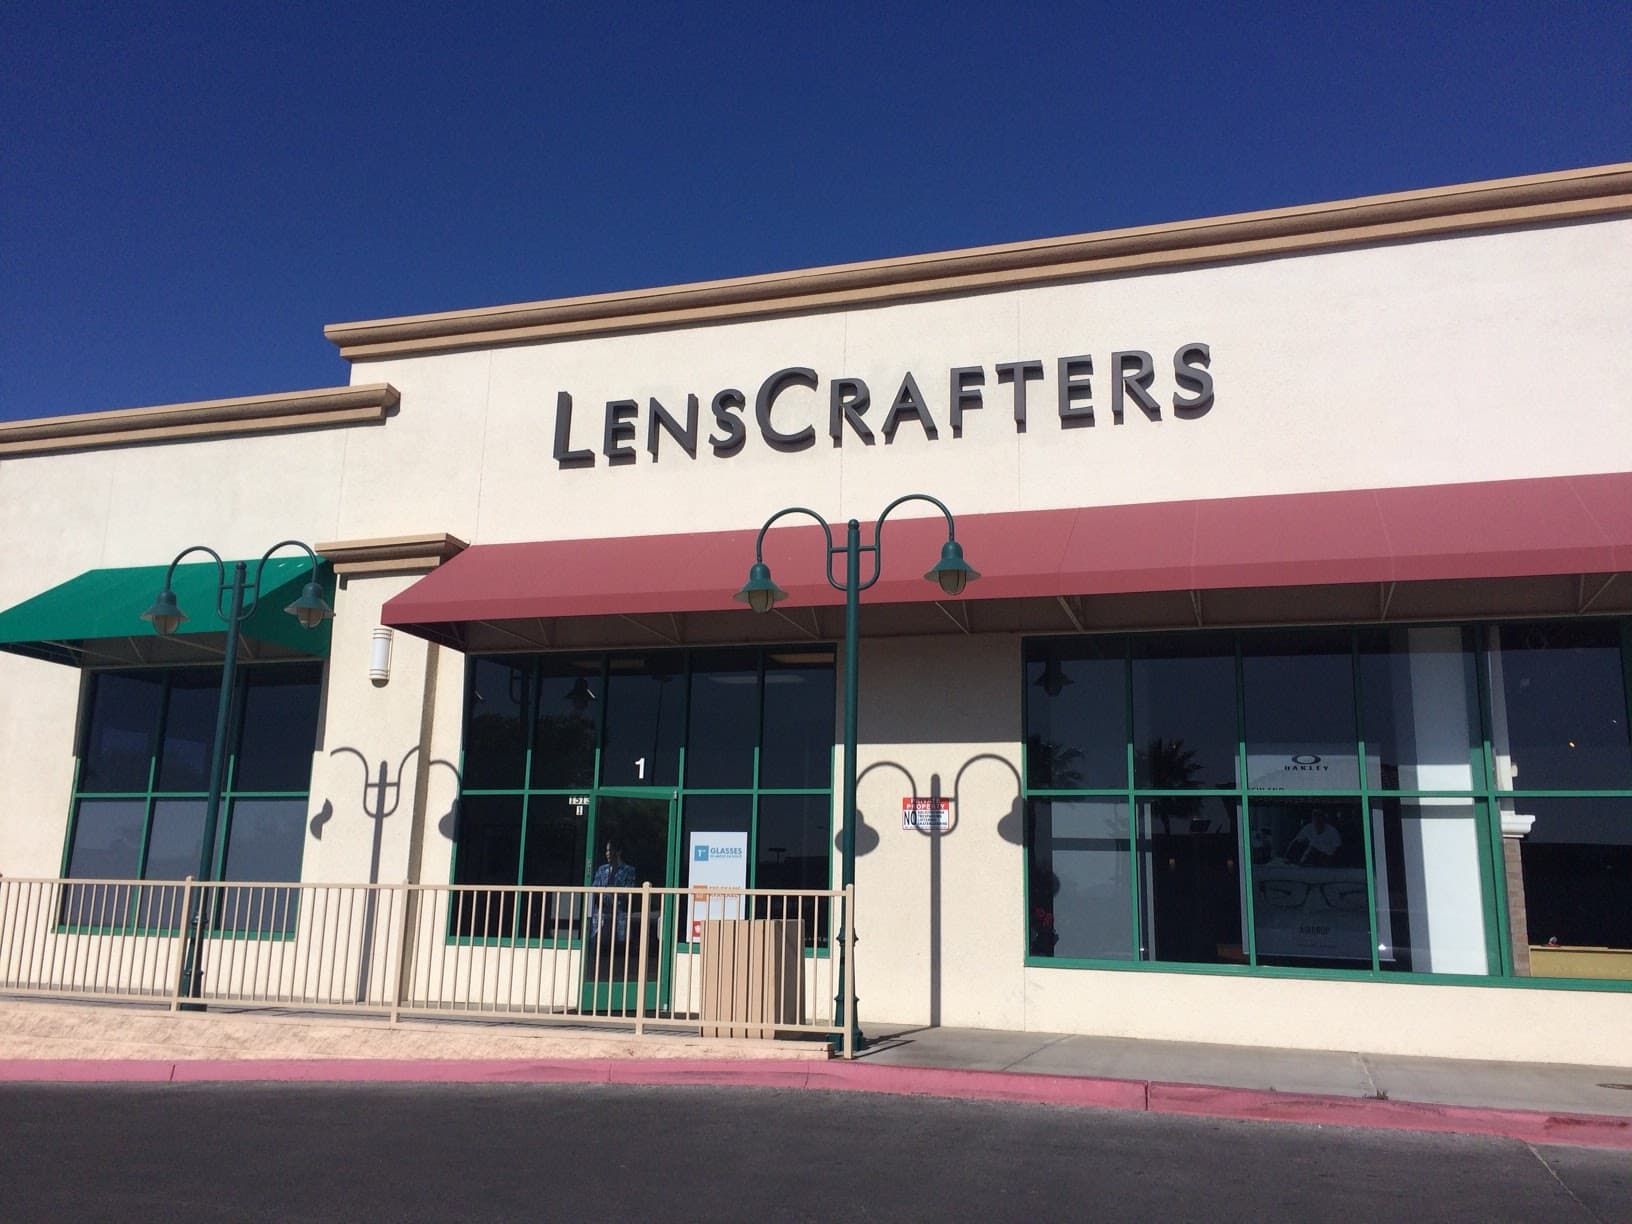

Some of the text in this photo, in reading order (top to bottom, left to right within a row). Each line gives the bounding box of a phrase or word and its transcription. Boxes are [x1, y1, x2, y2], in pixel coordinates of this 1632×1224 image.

[635, 758, 644, 779] 1
[904, 810, 917, 826] NO
[710, 847, 743, 855] GLASSES
